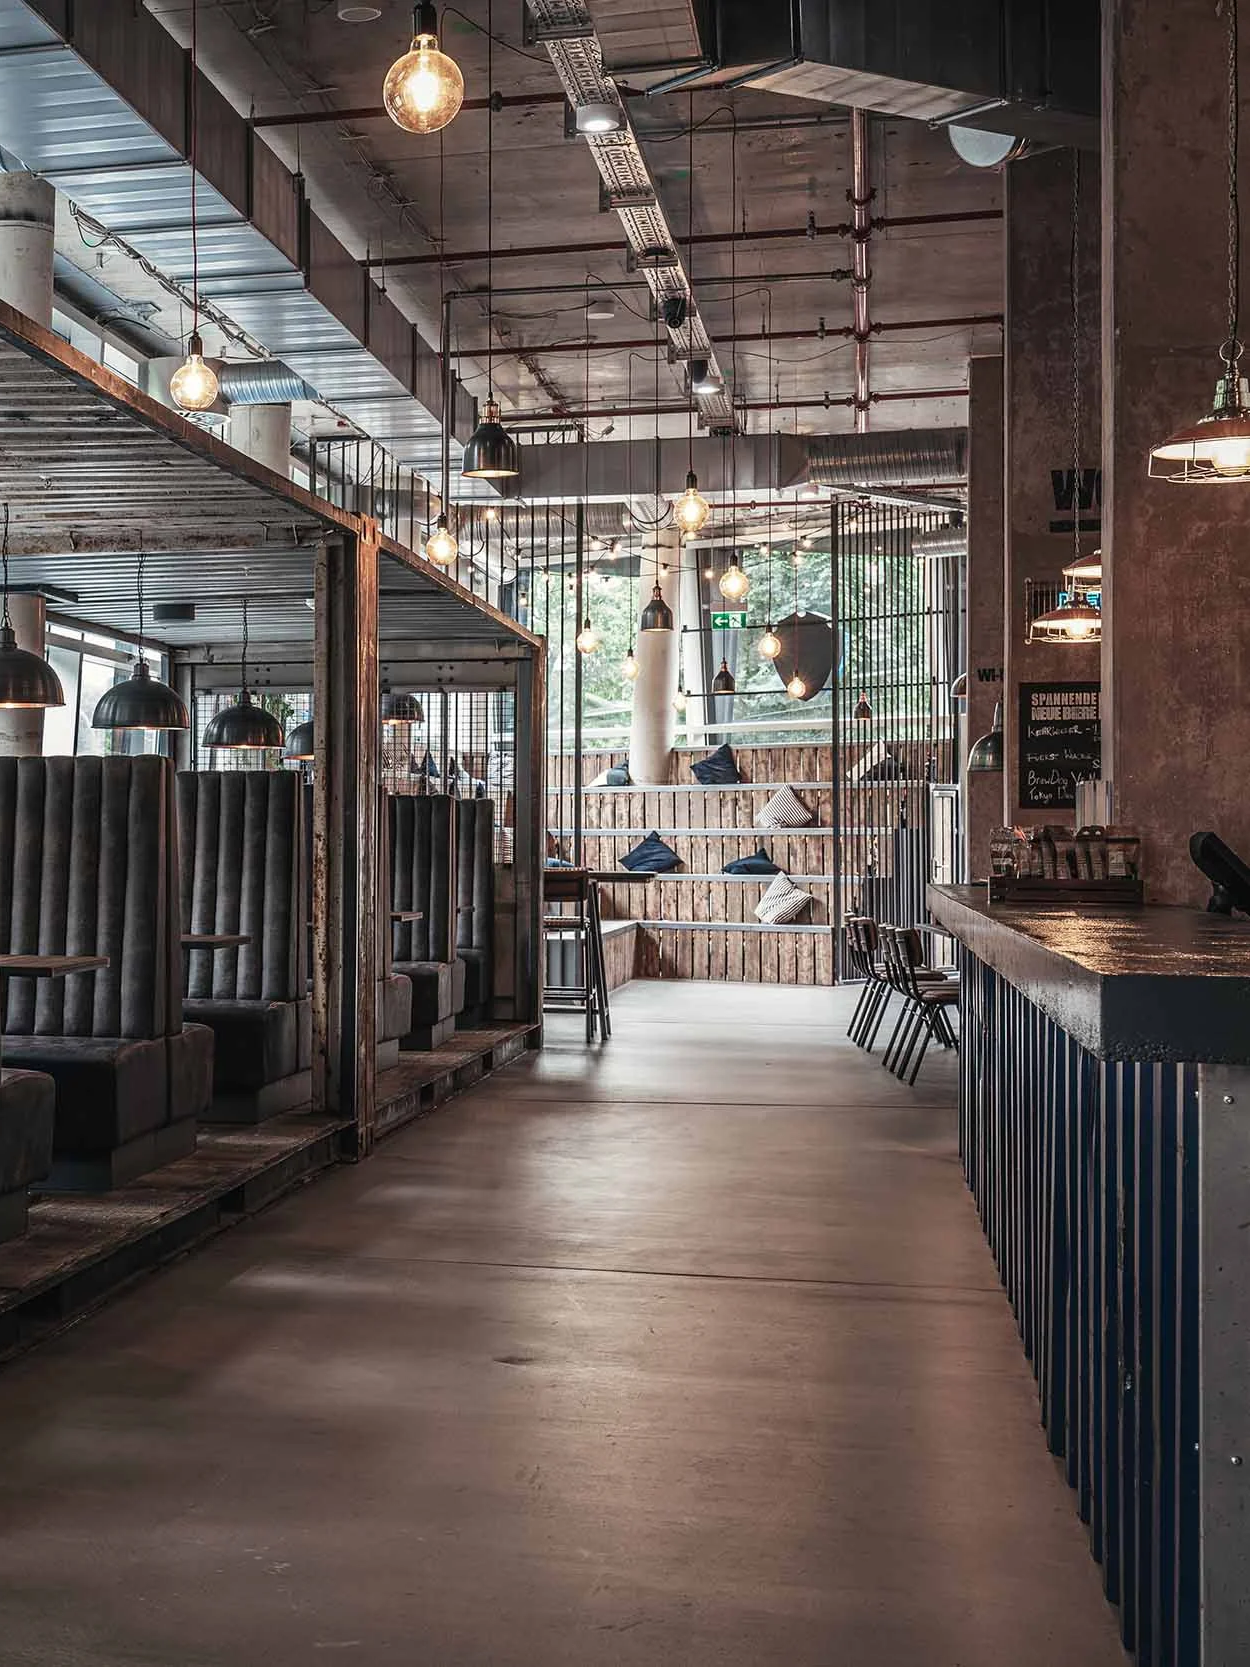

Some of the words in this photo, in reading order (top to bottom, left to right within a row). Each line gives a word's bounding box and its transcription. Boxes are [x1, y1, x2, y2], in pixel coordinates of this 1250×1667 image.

[1031, 692, 1097, 706] SPANNENDE
[1031, 706, 1062, 721] NEUE
[1062, 706, 1097, 721] BIERE
